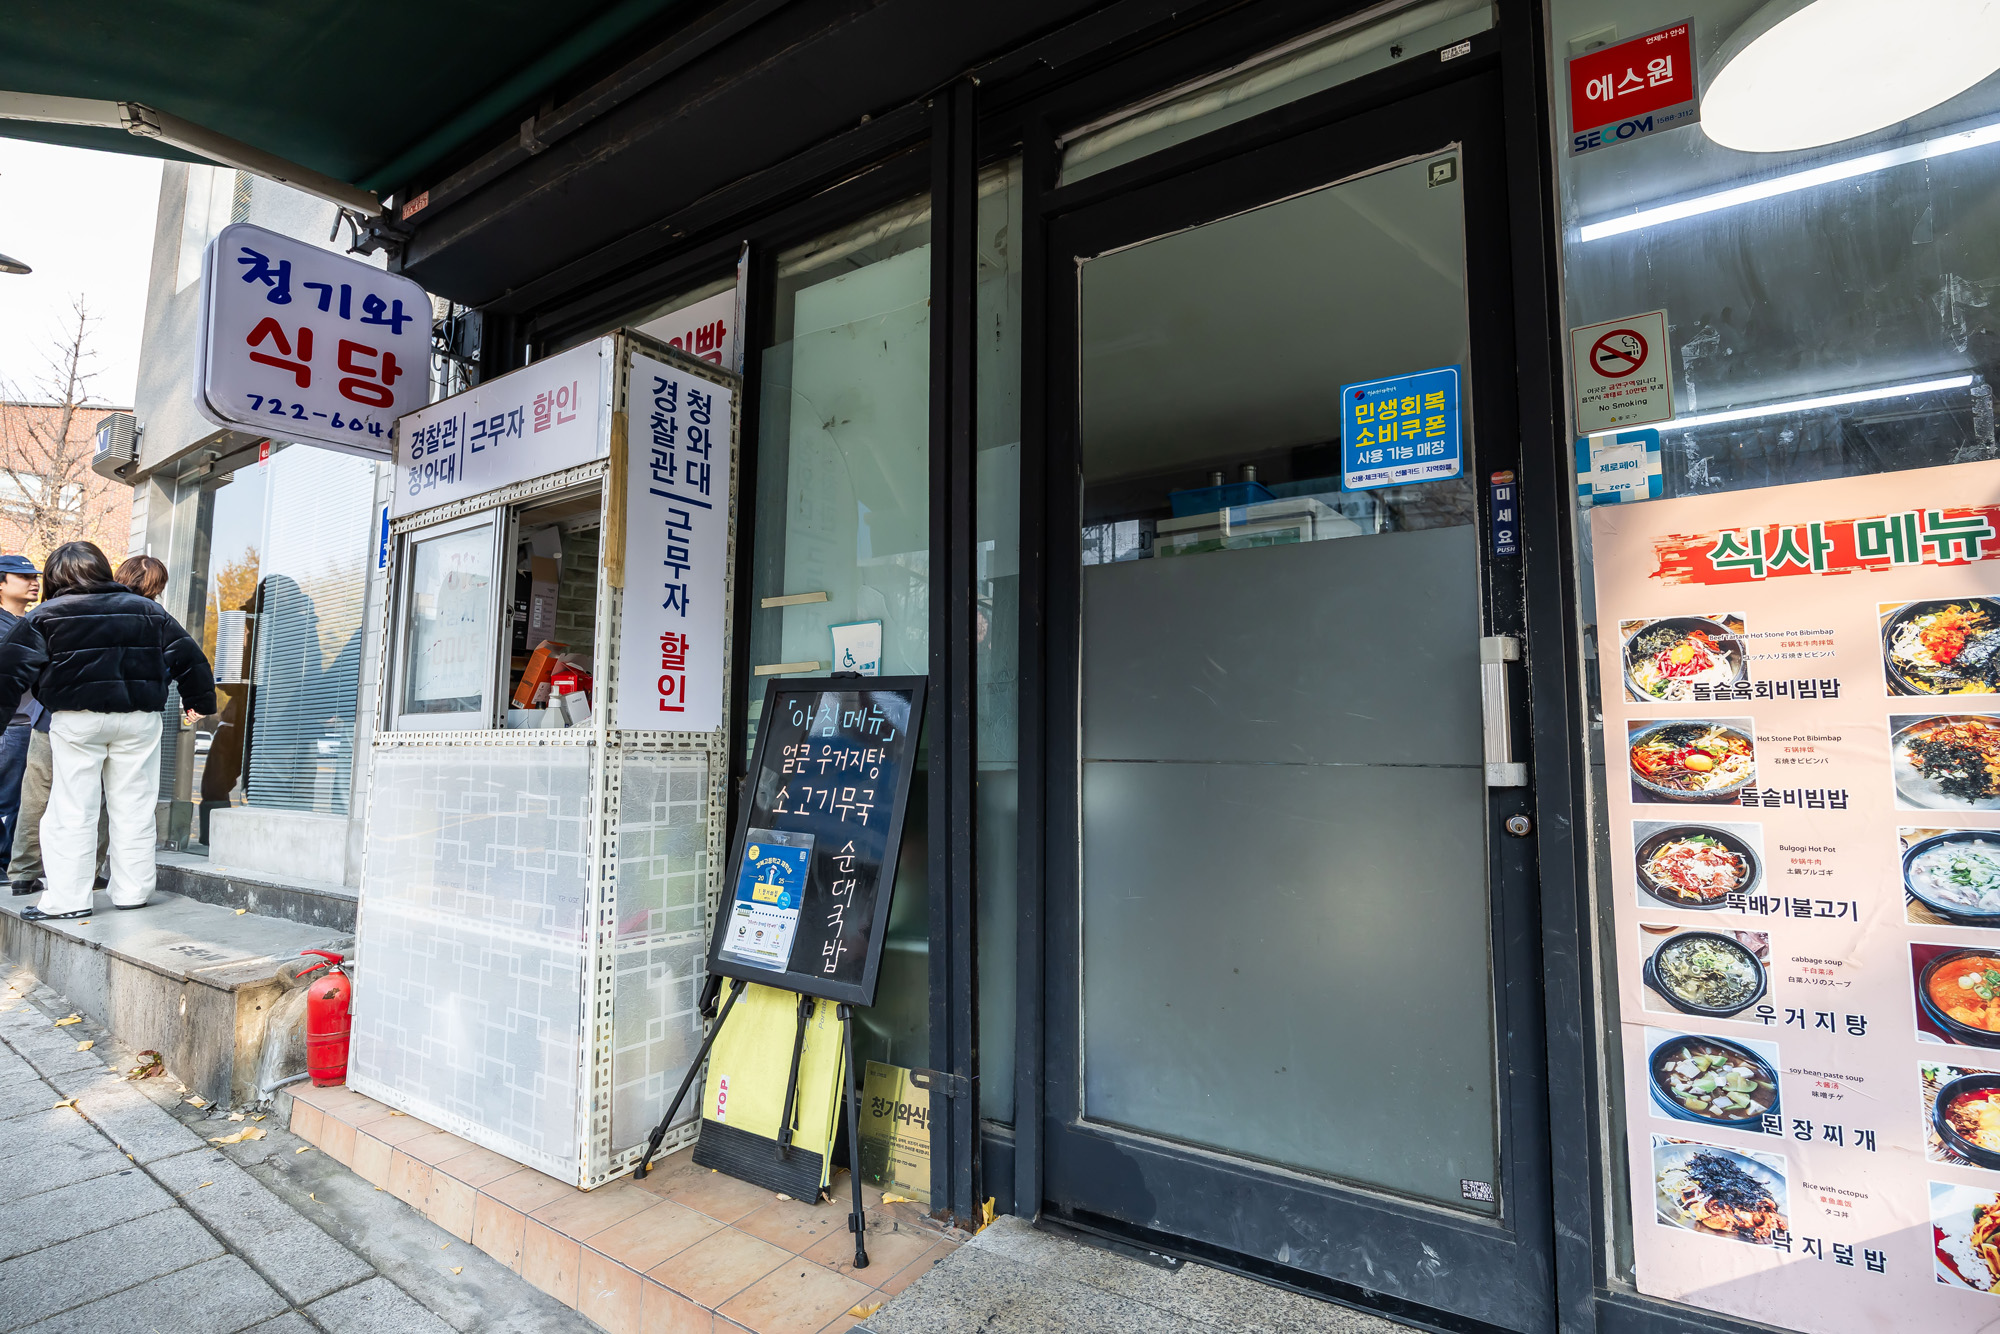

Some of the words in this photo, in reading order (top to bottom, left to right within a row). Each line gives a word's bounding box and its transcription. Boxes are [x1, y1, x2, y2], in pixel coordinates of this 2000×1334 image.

[1646, 33, 1668, 45] 언제나
[1670, 27, 1685, 37] 안심
[1585, 55, 1673, 102] 에스원
[1574, 116, 1653, 152] SECOM
[1656, 109, 1694, 124] 1588-3112
[237, 247, 413, 335] 청기와
[246, 317, 403, 408] 식당
[1355, 390, 1446, 425] 민생회복
[1587, 386, 1606, 394] 이곳은
[1612, 399, 1648, 410] Smoking
[411, 415, 458, 460] 경찰관
[470, 405, 525, 453] 근무자
[533, 380, 578, 433] 할인
[650, 376, 678, 486] 경찰관
[1355, 414, 1447, 448] 소비쿠폰
[685, 389, 712, 496] 청와대
[1357, 449, 1384, 465] 사용
[1386, 445, 1414, 460] 가능
[1417, 440, 1446, 457] 매장
[408, 453, 456, 497] 청와대
[1394, 467, 1420, 478] 선불카드
[1600, 459, 1638, 473] 제로페이
[1496, 487, 1513, 544] 미세요
[1497, 546, 1515, 554] PUSH
[1709, 522, 1831, 577] 식사
[1854, 511, 1993, 565] 메뉴
[662, 507, 692, 617] 근무자
[1726, 632, 1749, 640] Tartare
[1799, 628, 1834, 637] Bibimbap
[657, 631, 690, 712] 할인
[1692, 678, 1841, 701] 돌솥육회비빔밥
[1807, 735, 1842, 743] Bibimbap
[782, 744, 811, 774] 얼큰
[816, 744, 886, 779] 우거지탕
[772, 785, 875, 826] 소고기무국
[1739, 787, 1849, 810] 돌솥비빔밥
[1779, 844, 1807, 853] Bulgogi
[822, 840, 857, 973] 순대국밥
[1726, 893, 1858, 922] 뚝배기불고기
[1791, 956, 1823, 965] cabbage
[1824, 959, 1843, 967] soup
[1755, 1004, 1868, 1036] 우거지탕
[1789, 1067, 1802, 1075] soy
[1803, 1068, 1822, 1077] bean
[1823, 1072, 1844, 1080] paste
[1845, 1074, 1864, 1083] soup
[716, 1078, 729, 1116] TOP
[1763, 1114, 1877, 1152] 된장찌개
[1802, 1182, 1818, 1190] Rice
[1819, 1185, 1836, 1193] with
[1838, 1188, 1869, 1199] octopus
[1771, 1230, 1887, 1274] 낙지덮밥
